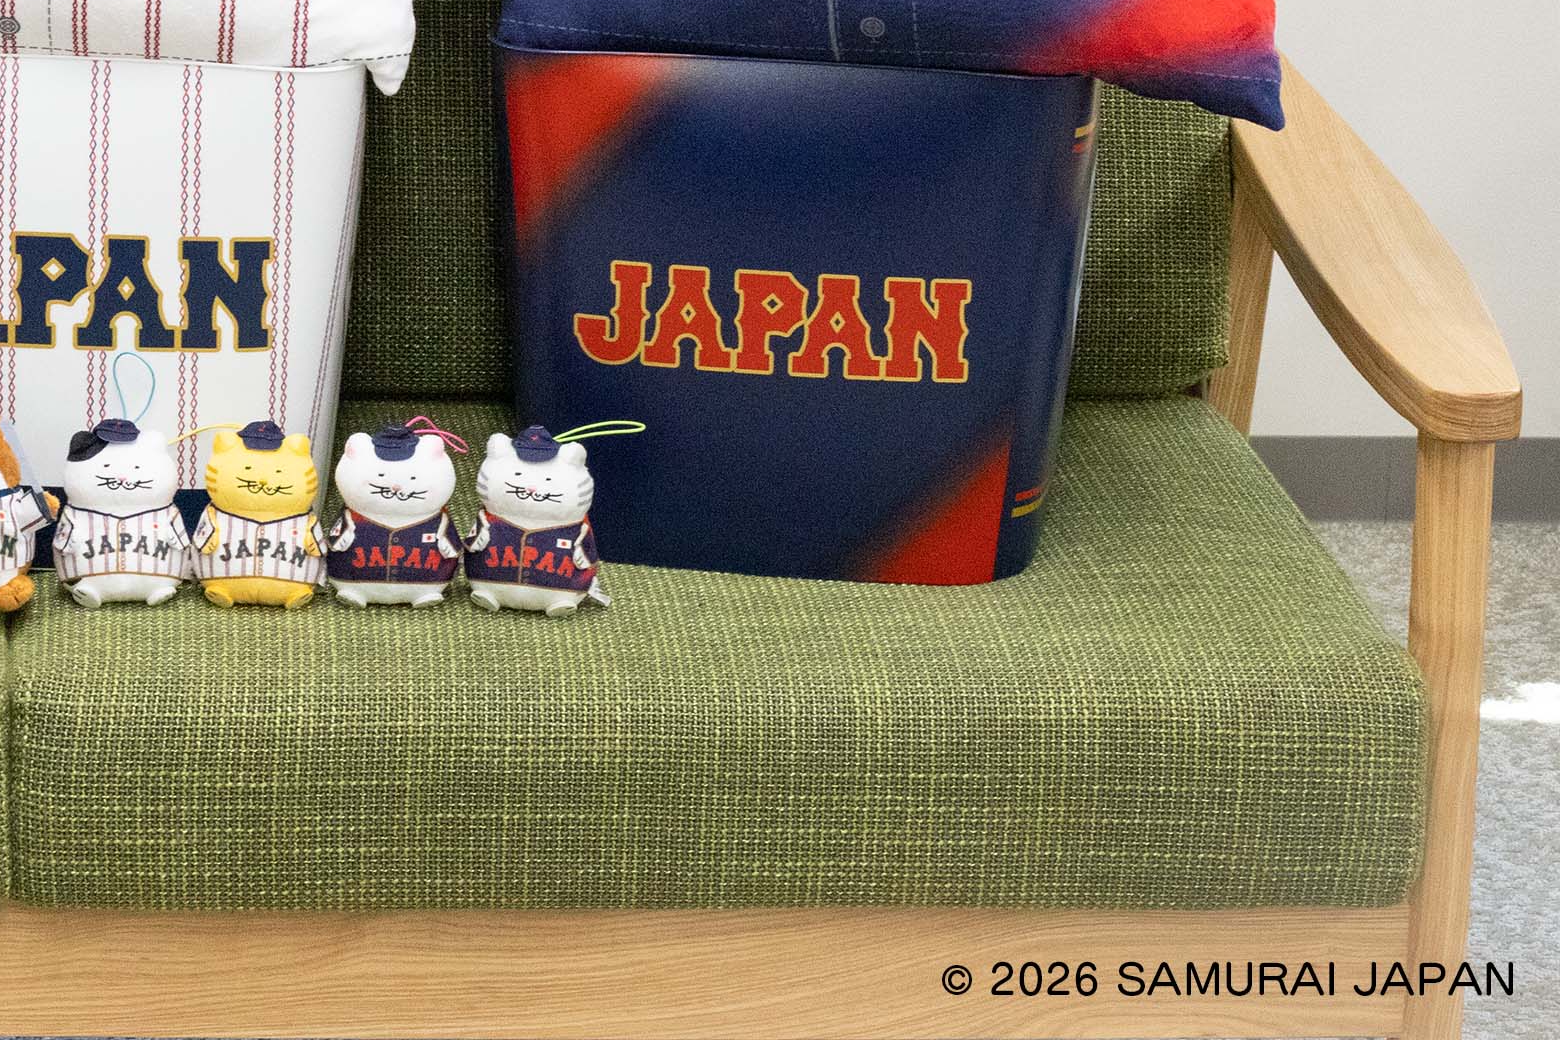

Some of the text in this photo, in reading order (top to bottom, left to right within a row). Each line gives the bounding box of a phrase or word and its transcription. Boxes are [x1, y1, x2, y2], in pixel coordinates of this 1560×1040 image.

[573, 260, 972, 383] JAPAN
[83, 533, 169, 561] JAPAN
[220, 538, 307, 568] JAPAN
[352, 546, 441, 571] JAPAN
[486, 546, 575, 578] JAPAN
